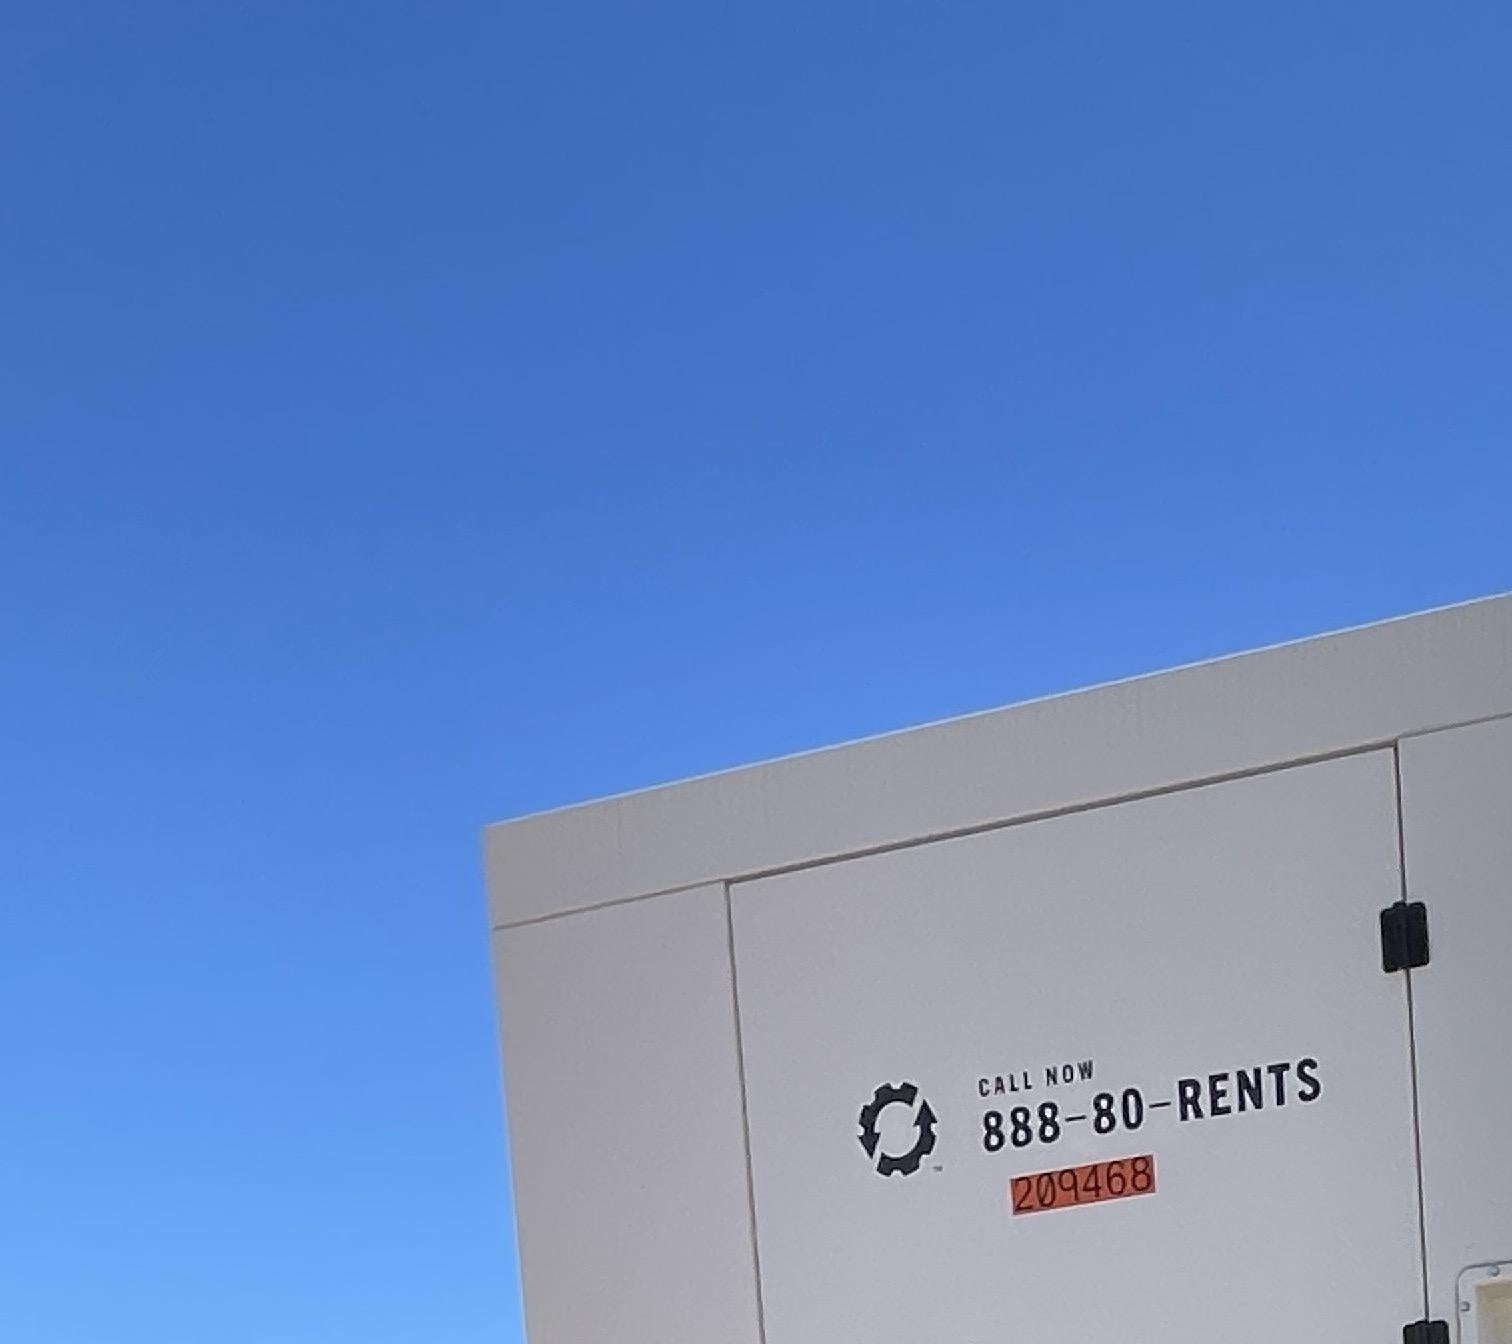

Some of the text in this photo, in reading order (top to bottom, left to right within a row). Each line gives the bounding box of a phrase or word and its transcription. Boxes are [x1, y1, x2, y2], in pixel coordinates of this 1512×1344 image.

[978, 1060, 1093, 1097] CALL NOW
[983, 1058, 1321, 1152] 888-80-RENTS
[1014, 1156, 1151, 1210] 209468
